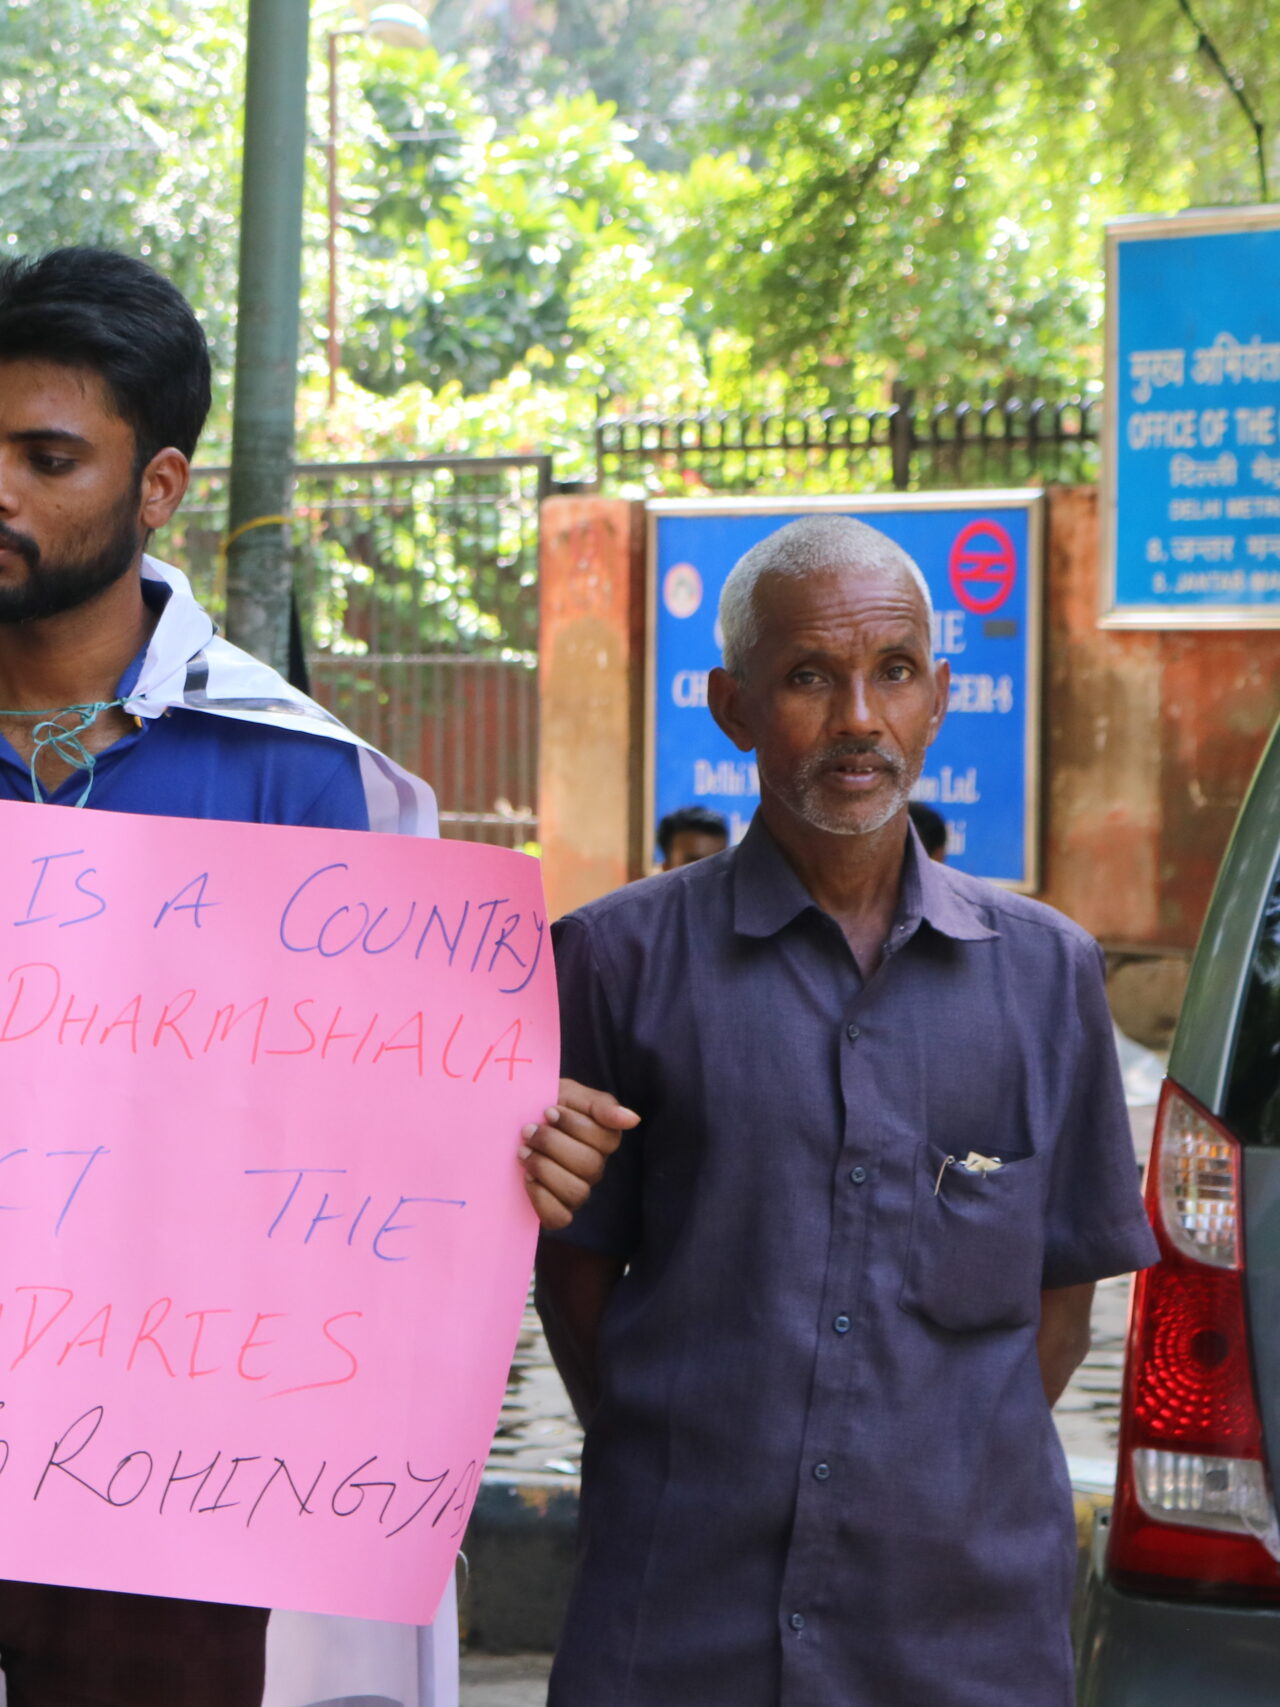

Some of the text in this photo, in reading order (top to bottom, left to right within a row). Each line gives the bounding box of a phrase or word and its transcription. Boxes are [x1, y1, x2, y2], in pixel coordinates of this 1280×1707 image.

[1128, 405, 1276, 450] OFFICE OF THE
[14, 850, 107, 928] IS
[154, 872, 221, 929] A
[280, 863, 543, 993] COUNTRY
[245, 1169, 465, 1261] THE
